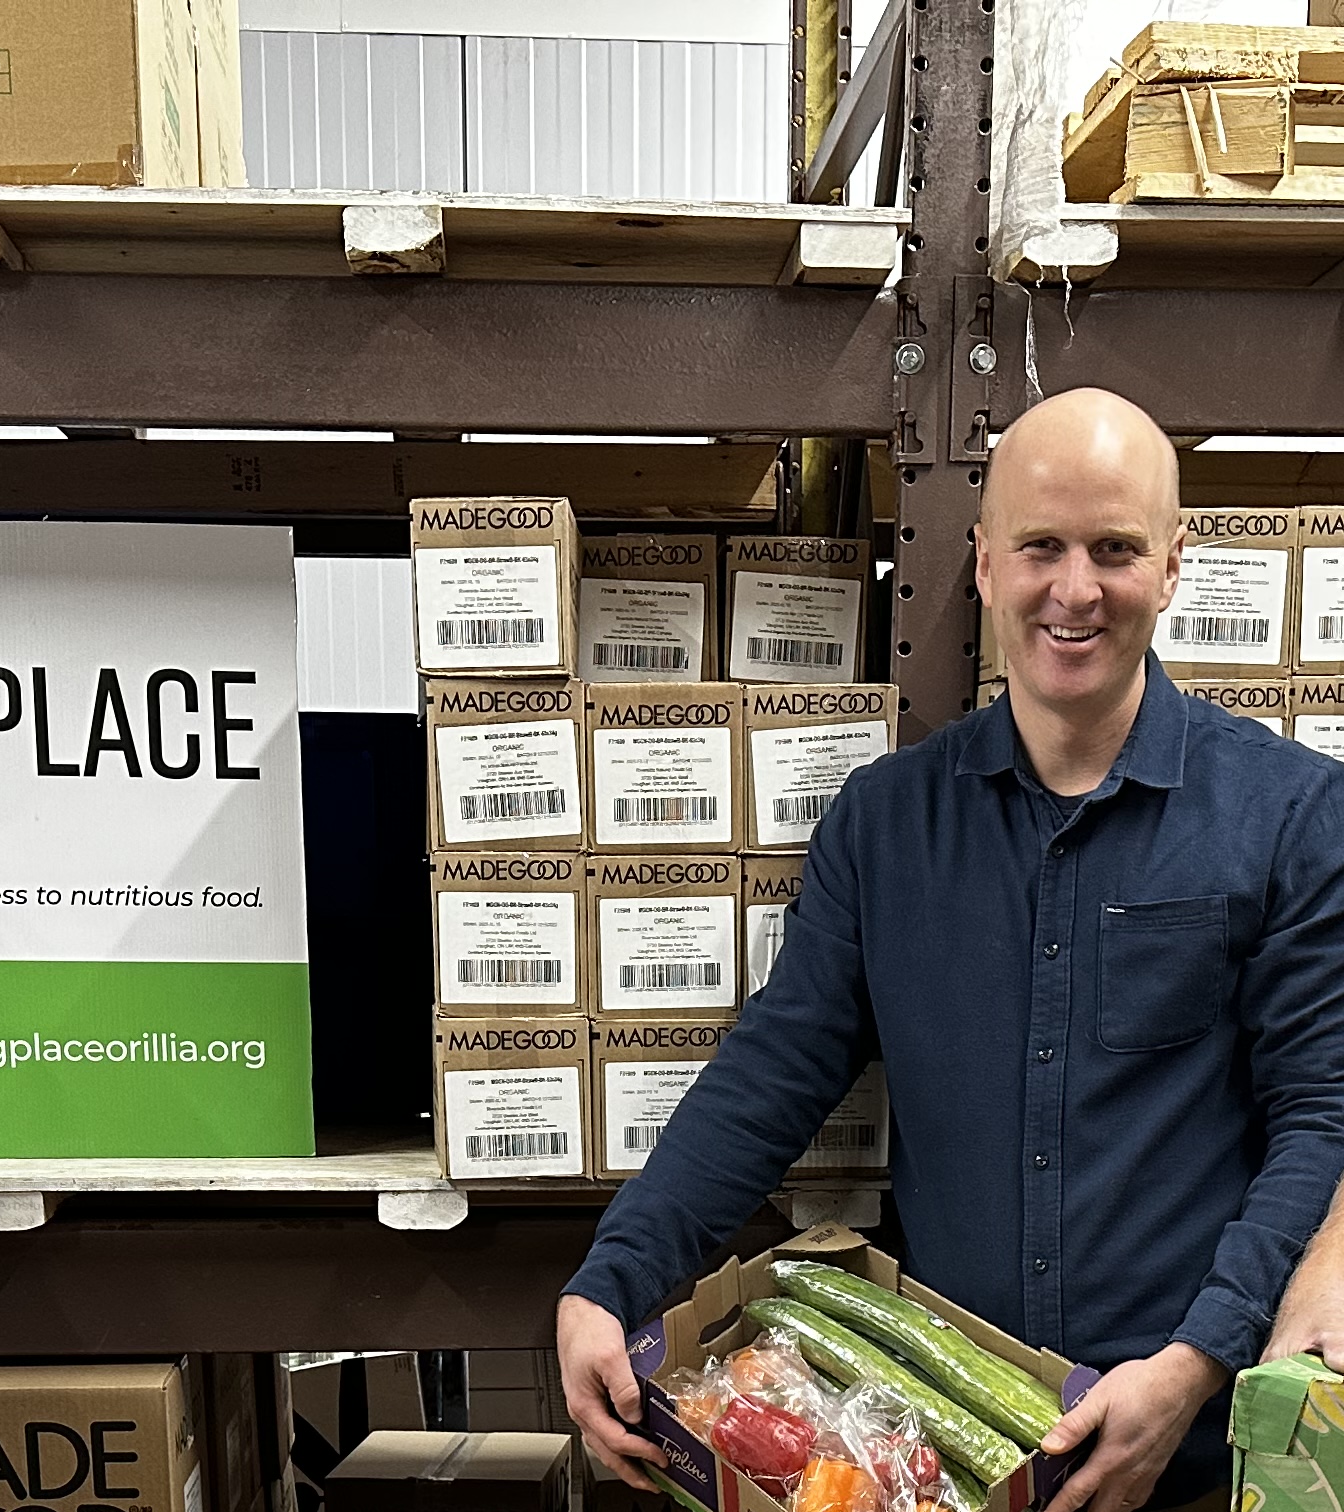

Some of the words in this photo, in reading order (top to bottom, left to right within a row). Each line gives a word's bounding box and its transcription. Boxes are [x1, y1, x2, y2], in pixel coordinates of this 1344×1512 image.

[420, 507, 553, 531] MADEGOOD
[584, 545, 703, 567] MADEGOOD
[738, 542, 858, 563] MADEGOOD
[441, 690, 572, 712] MADEGOOD
[755, 693, 883, 715] MADEGOOD
[601, 703, 731, 726] MADEGOOD
[443, 859, 572, 881] MADEGOOD
[602, 862, 730, 884] MADEGOOD
[36, 885, 62, 906] to
[72, 885, 193, 908] nutritious
[201, 886, 264, 909] food.
[449, 1028, 576, 1050] MADEGOOD
